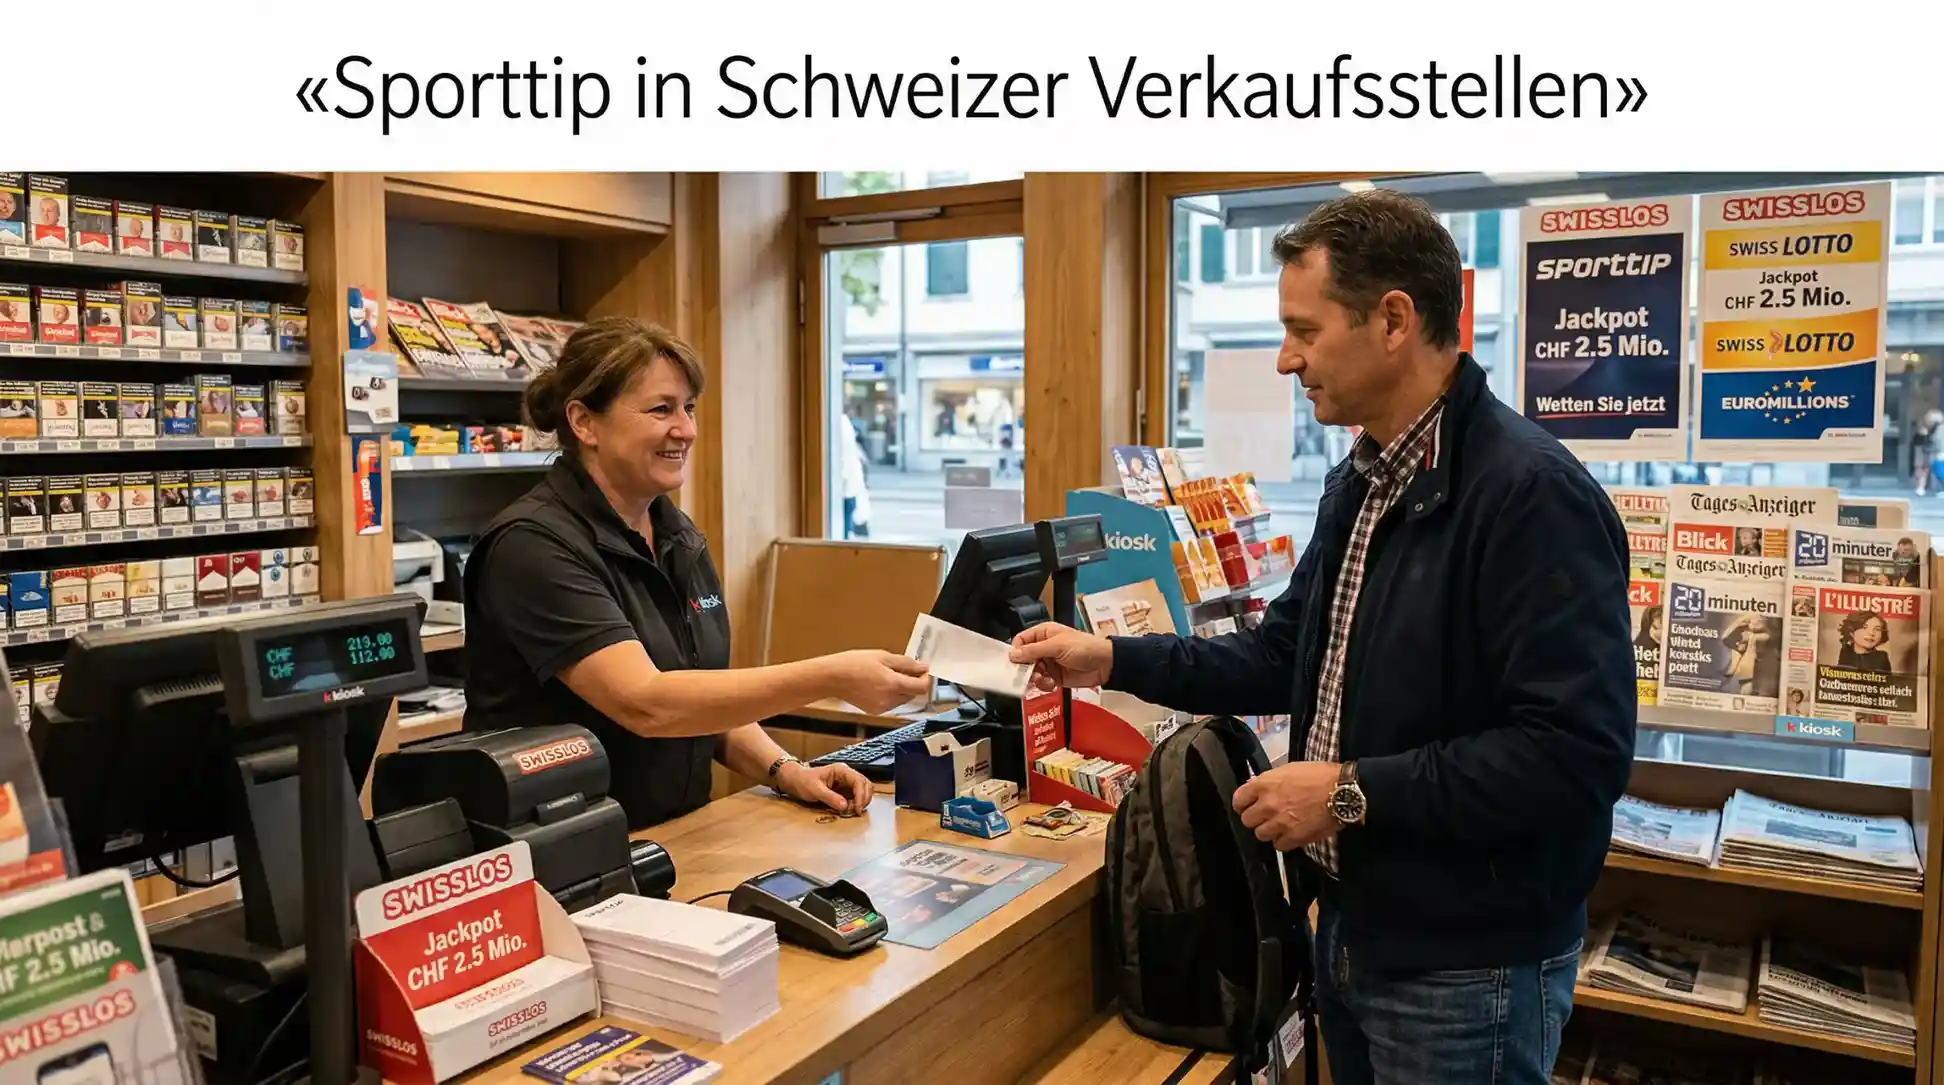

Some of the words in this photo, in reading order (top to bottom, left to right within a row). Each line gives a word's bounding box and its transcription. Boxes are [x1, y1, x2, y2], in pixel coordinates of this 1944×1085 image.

[1540, 204, 1669, 233] SWISSLOS
[1722, 190, 1866, 222] SWISSLOS
[1729, 240, 1778, 256] SWISS
[1782, 233, 1854, 256] LOTTO
[1759, 270, 1819, 286] Jackpot
[1724, 296, 1756, 310] CHF
[1759, 288, 1796, 308] 2.5
[1802, 286, 1851, 307] Mio.
[1554, 306, 1649, 333] Jackpot
[1535, 342, 1571, 359] CHF
[1574, 335, 1613, 358] 2.5
[1618, 335, 1669, 356] Mio.
[1716, 338, 1765, 352] SWISS
[1784, 332, 1855, 353] LOTTO
[1536, 396, 1594, 412] Wetten
[1597, 396, 1624, 412] Sie
[1625, 396, 1666, 415] jetzt
[1690, 493, 1738, 514] Tages
[1747, 494, 1817, 518] Anzeiger
[1104, 531, 1157, 551] kiosk
[1676, 530, 1729, 551] Blick
[1798, 533, 1826, 559] 20
[1676, 554, 1718, 572] Tages
[1726, 557, 1787, 580] Anzeiger
[1674, 585, 1702, 611] 20
[1708, 595, 1777, 614] minuten
[1824, 592, 1914, 614] L'ILLUSTRÉ
[266, 646, 293, 664] CHF
[347, 632, 393, 651] 219.00
[269, 661, 295, 679] CHF
[350, 646, 396, 665] 112.00
[331, 686, 366, 702] kiosk
[1799, 722, 1842, 737] kiosk
[520, 739, 589, 770] SWISSLOS
[383, 853, 513, 920] SWISSLOS
[424, 909, 504, 956] Jackpot
[25, 951, 67, 984] 2.5
[69, 938, 122, 969] Mio.
[407, 956, 450, 991] CHF
[454, 942, 485, 975] 2.5
[488, 933, 528, 961] Mio.
[0, 988, 136, 1065] WISSLOS
[487, 1000, 548, 1038] SWISSLOS
